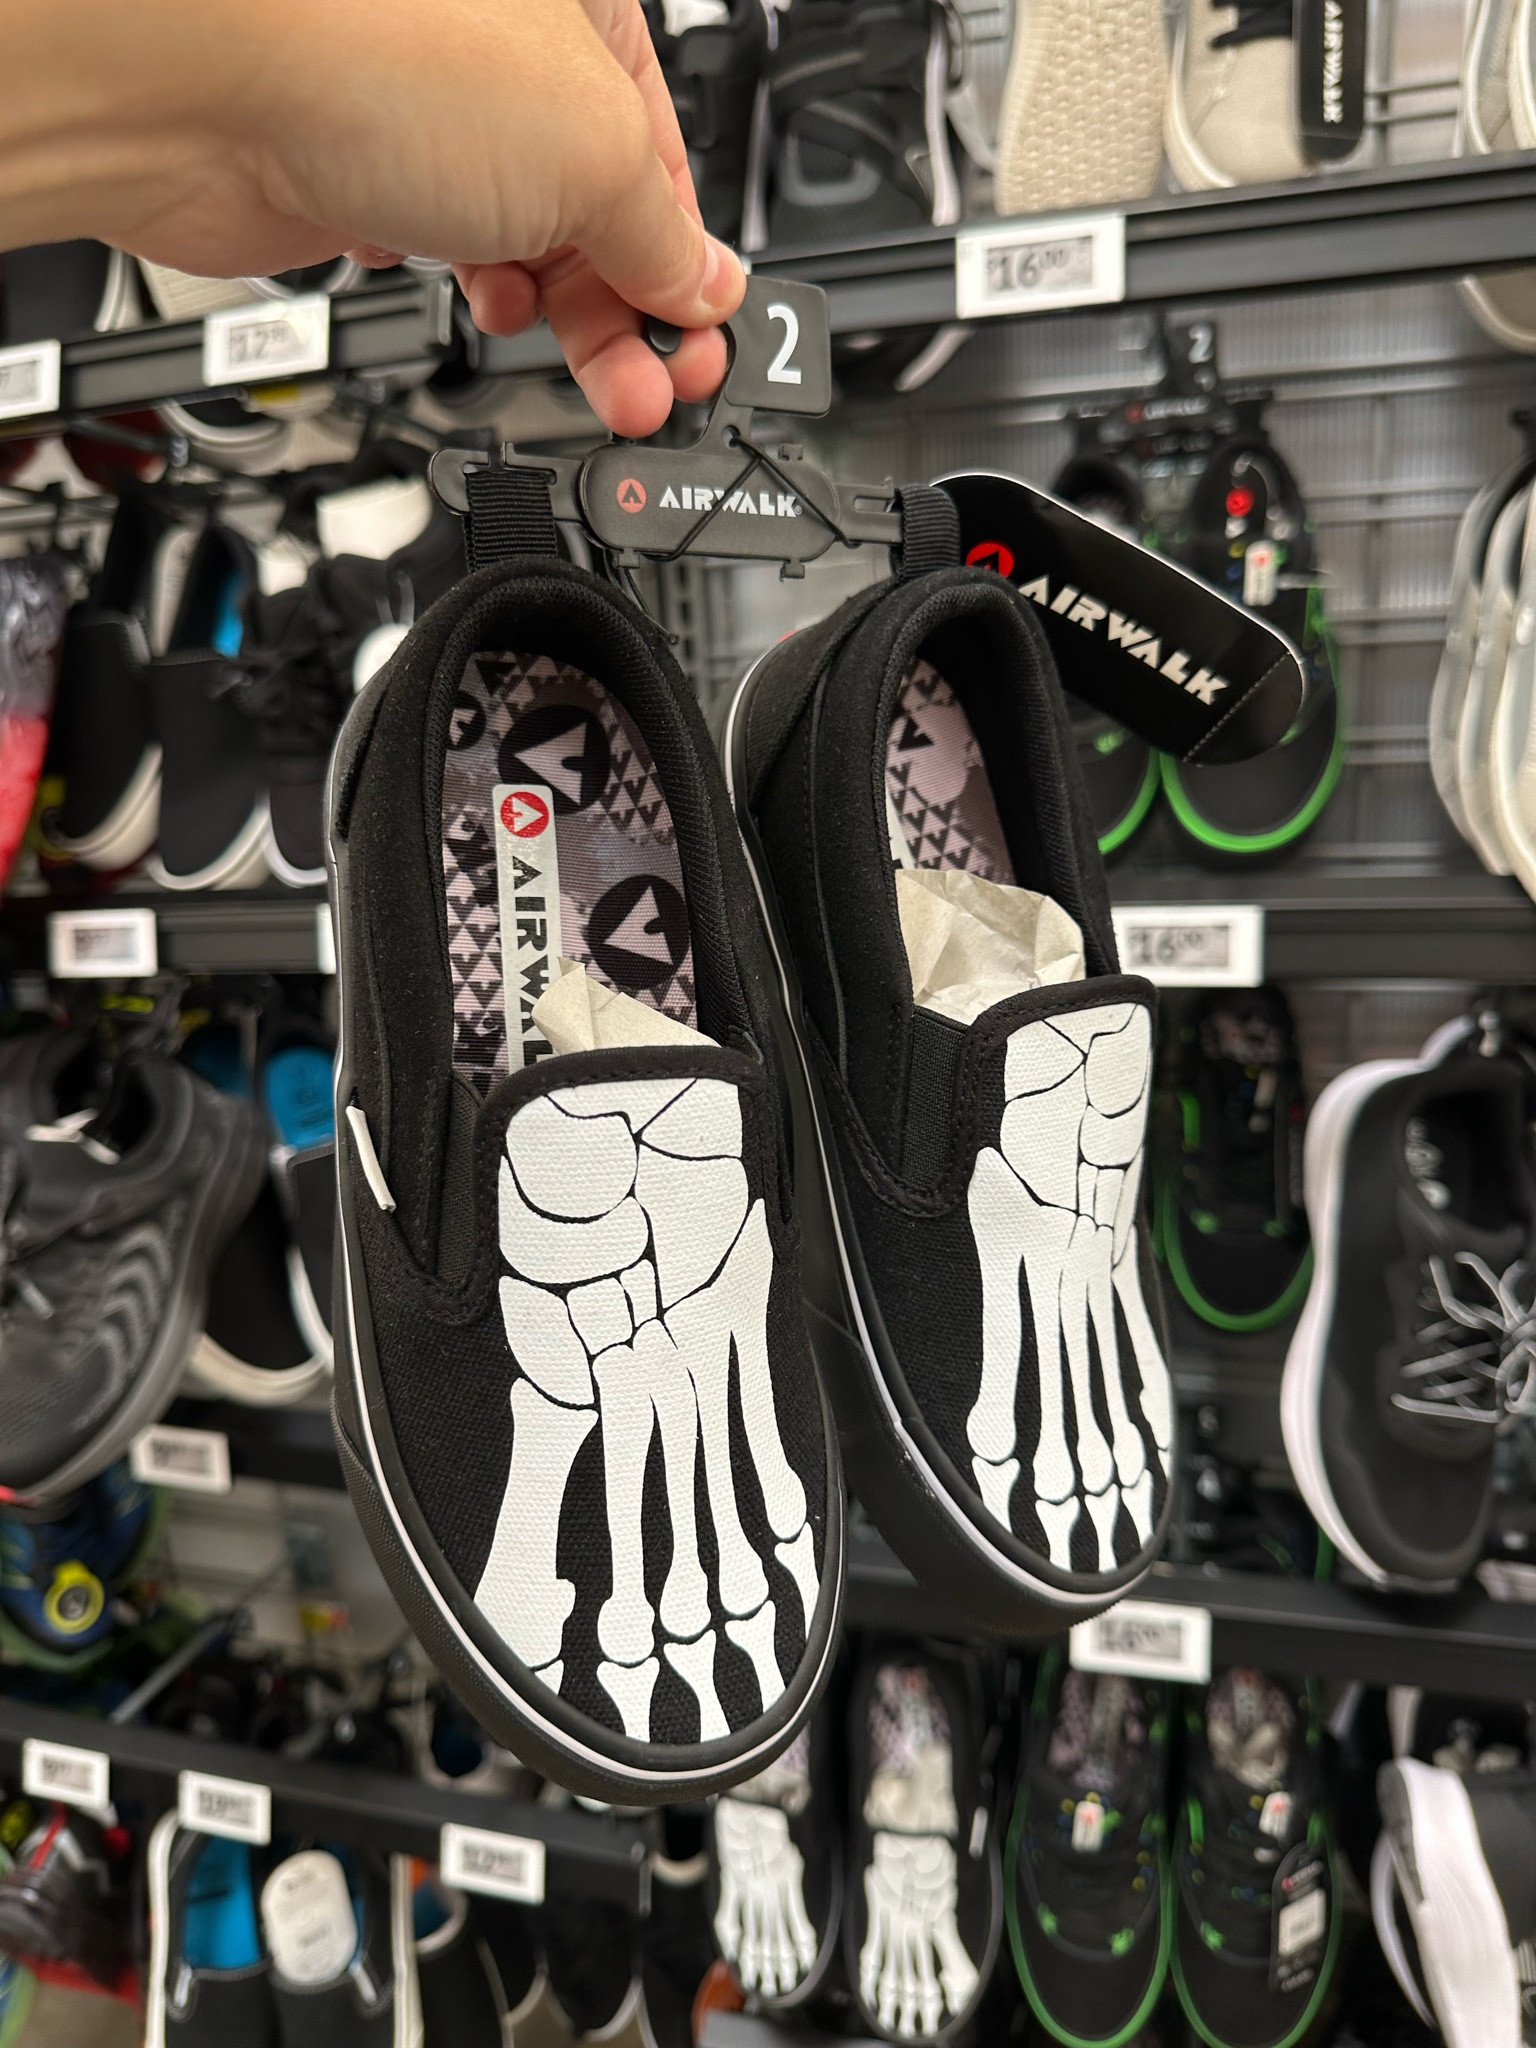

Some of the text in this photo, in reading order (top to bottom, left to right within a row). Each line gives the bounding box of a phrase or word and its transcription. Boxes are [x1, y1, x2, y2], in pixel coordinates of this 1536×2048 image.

[767, 302, 801, 384] 2
[1188, 324, 1214, 364] 2
[1018, 574, 1231, 706] AIRWALK
